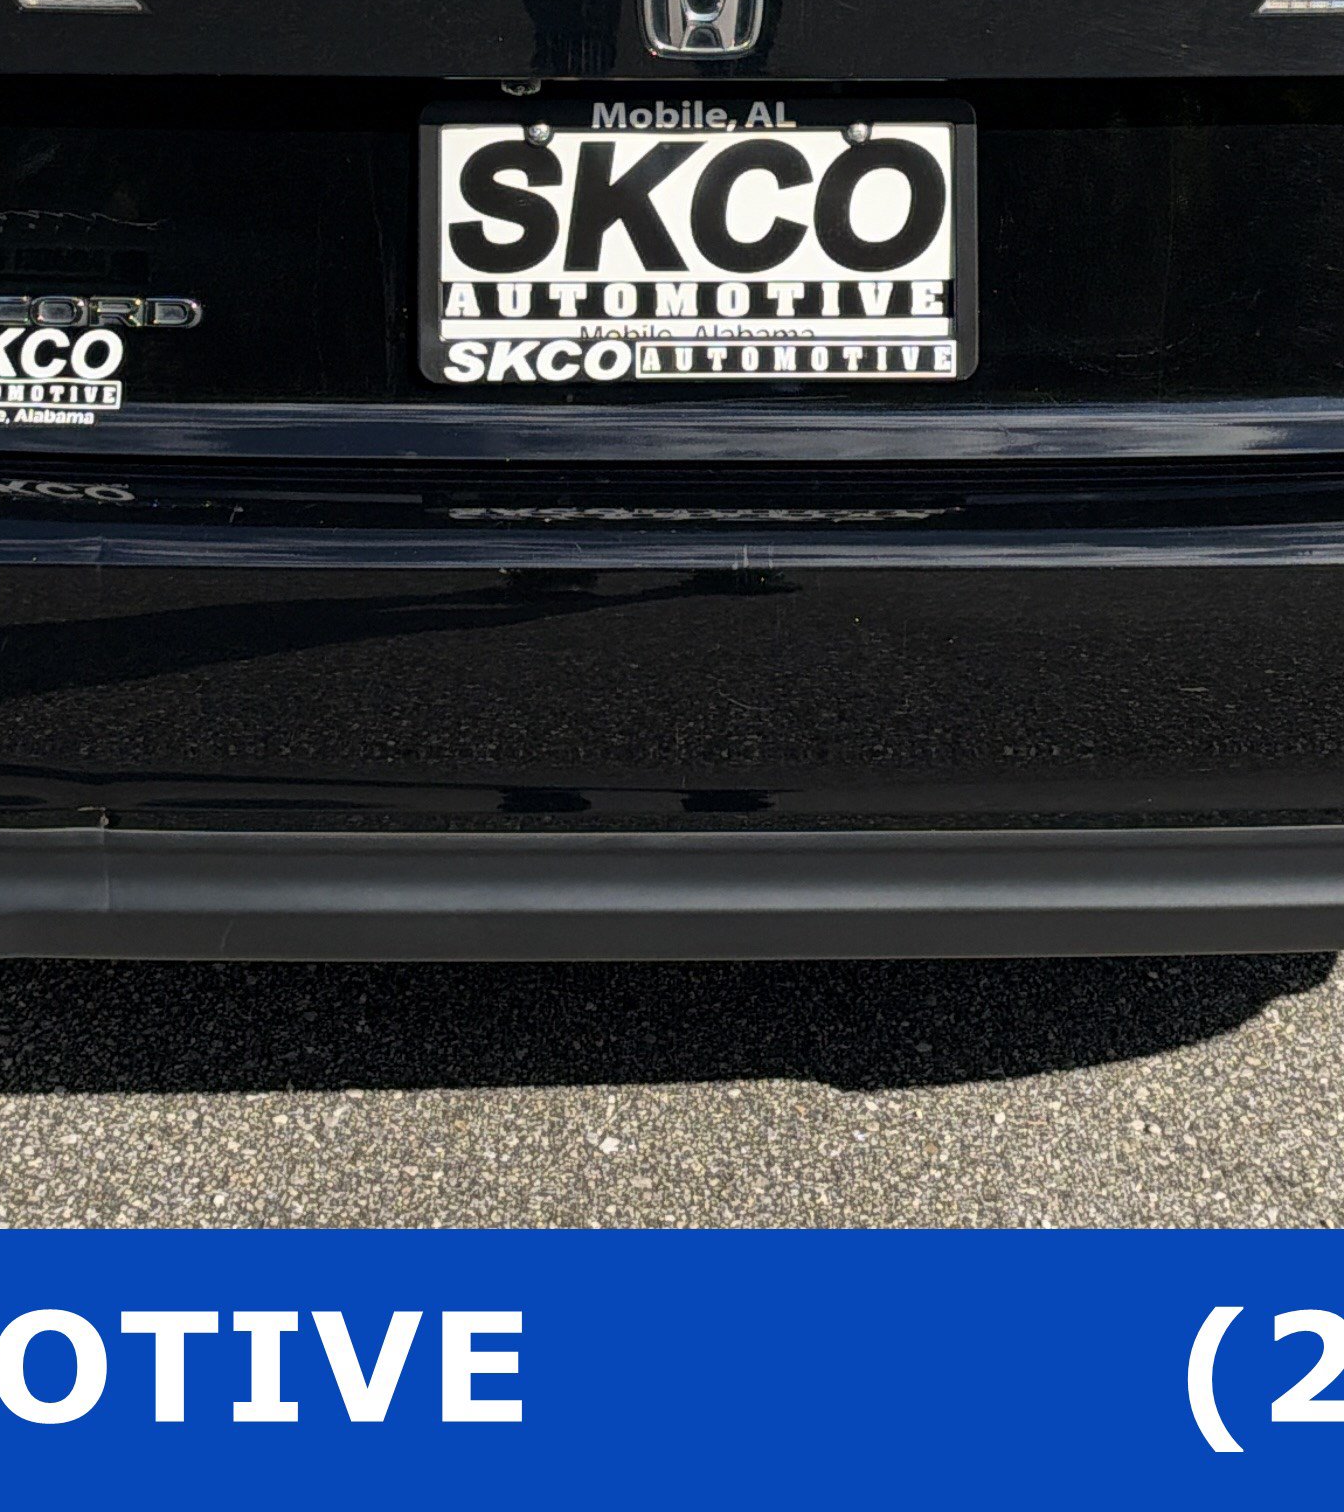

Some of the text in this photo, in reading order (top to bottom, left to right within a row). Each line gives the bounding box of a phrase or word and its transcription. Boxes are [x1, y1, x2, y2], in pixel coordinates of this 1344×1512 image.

[592, 100, 797, 131] Mobile, AL
[448, 138, 946, 274] SKCO
[445, 282, 944, 318] AUTOMOTIVE
[443, 339, 952, 382] SKCO AUTOMOTIVE
[14, 409, 95, 424] Alabama
